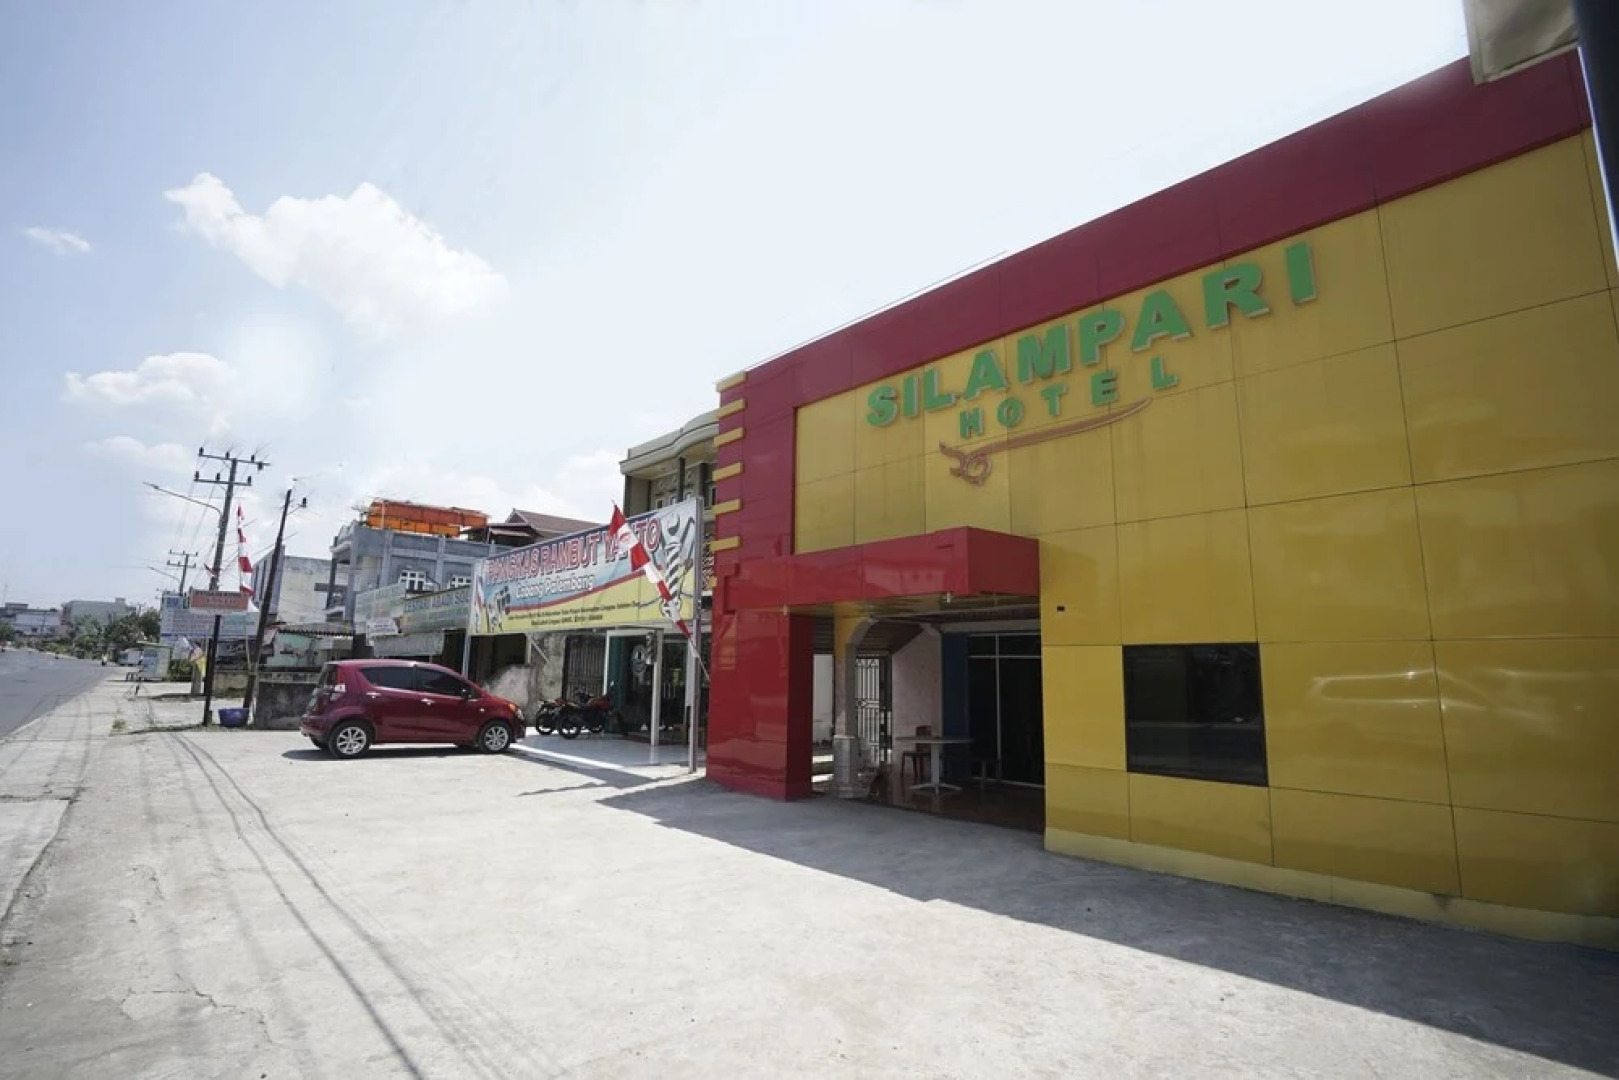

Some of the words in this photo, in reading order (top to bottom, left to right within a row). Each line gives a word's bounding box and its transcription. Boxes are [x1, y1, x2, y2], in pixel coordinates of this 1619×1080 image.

[866, 241, 1317, 428] SILAMPARI
[959, 355, 1179, 439] HOTEL
[486, 549, 540, 585] PANGKAS
[541, 534, 601, 575] RAMBUT
[545, 573, 596, 594] Palembang
